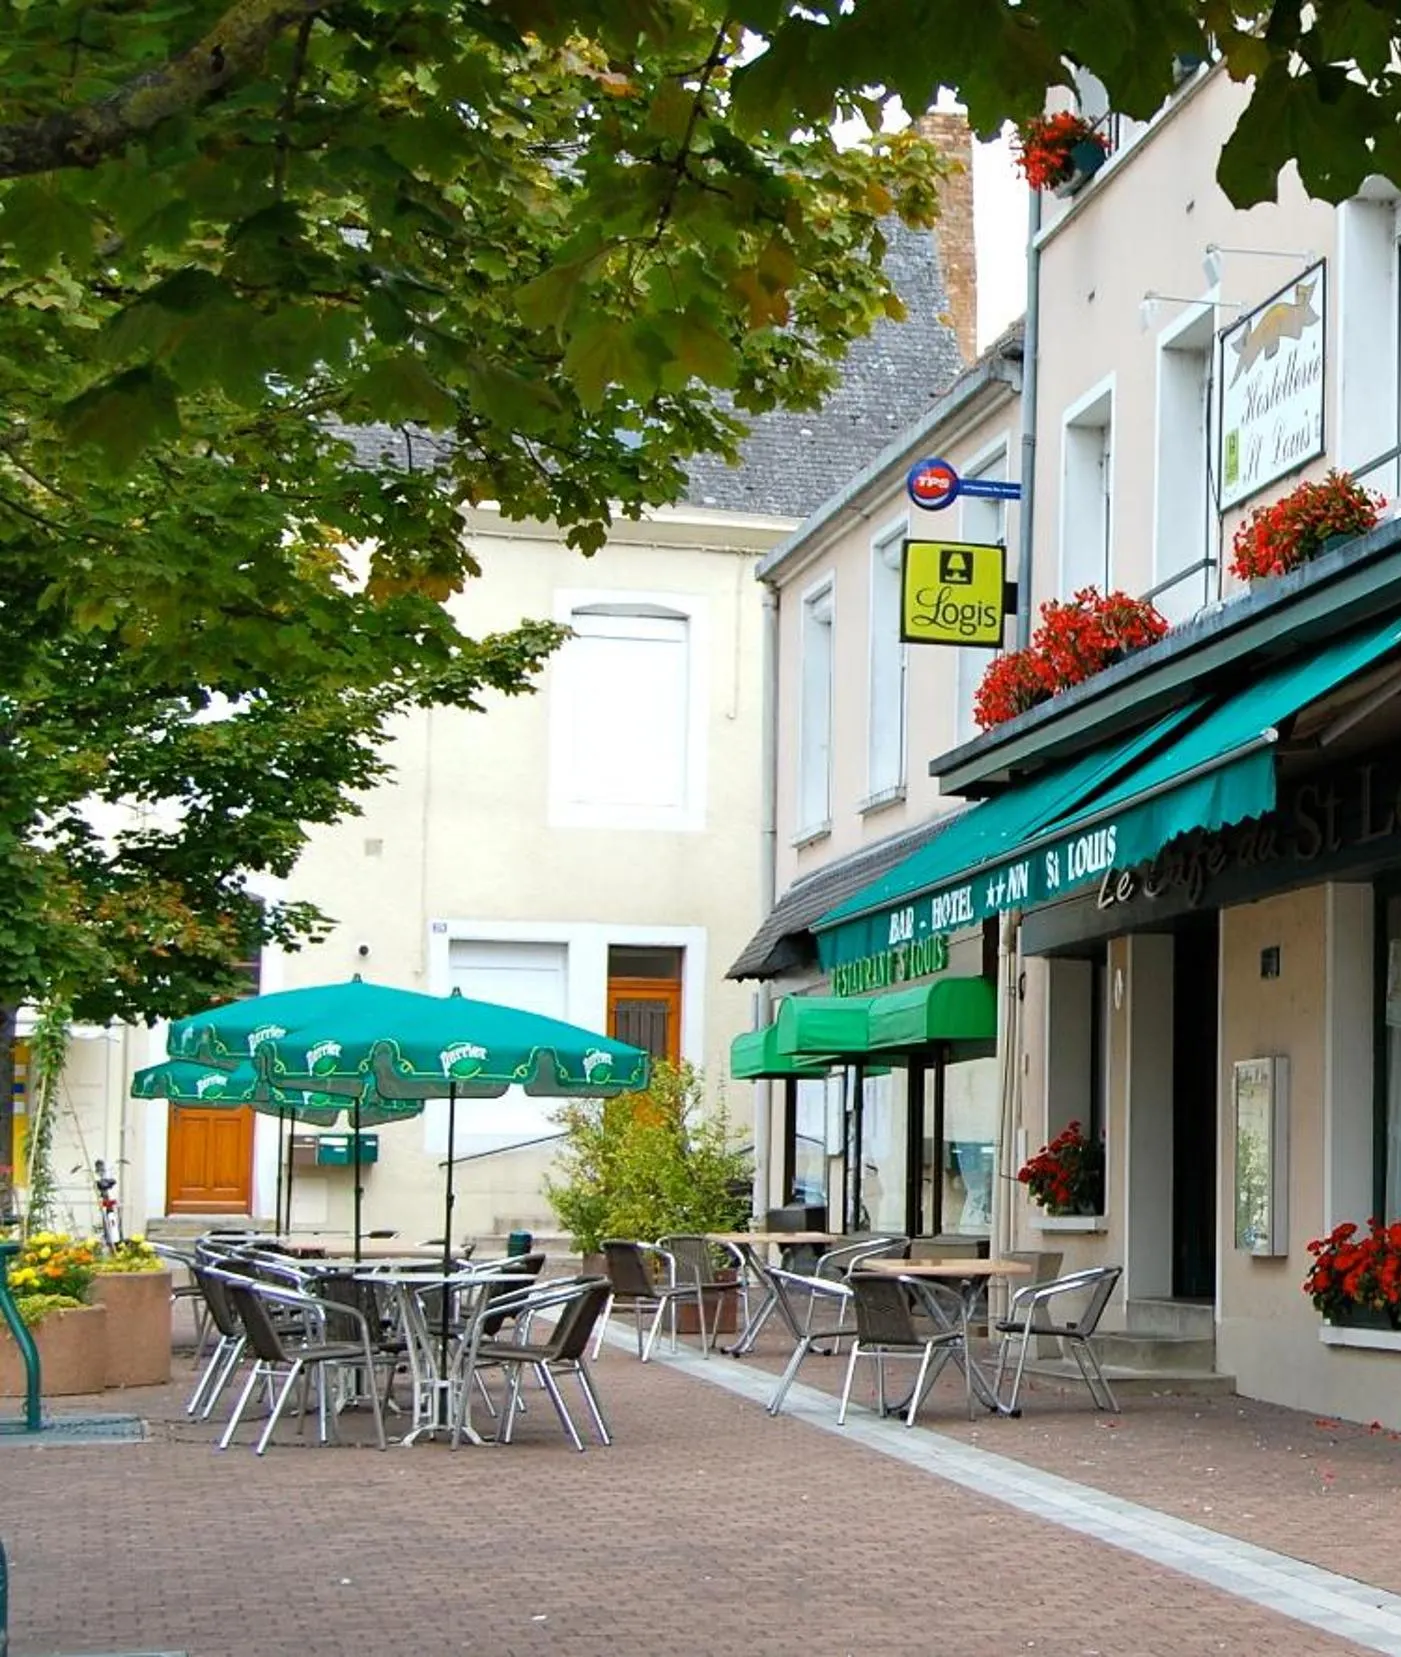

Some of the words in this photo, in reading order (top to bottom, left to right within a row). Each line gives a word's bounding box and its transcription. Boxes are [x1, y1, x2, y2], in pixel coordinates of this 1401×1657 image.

[911, 586, 997, 636] Logis
[1293, 783, 1342, 861] St
[888, 906, 915, 945] BAR
[931, 884, 975, 932] HOTEL
[1045, 850, 1061, 888] St
[1068, 824, 1118, 882] LOUIS
[248, 1025, 286, 1058] Perrier
[306, 1040, 343, 1076] Perrier
[440, 1041, 489, 1079] Perrier
